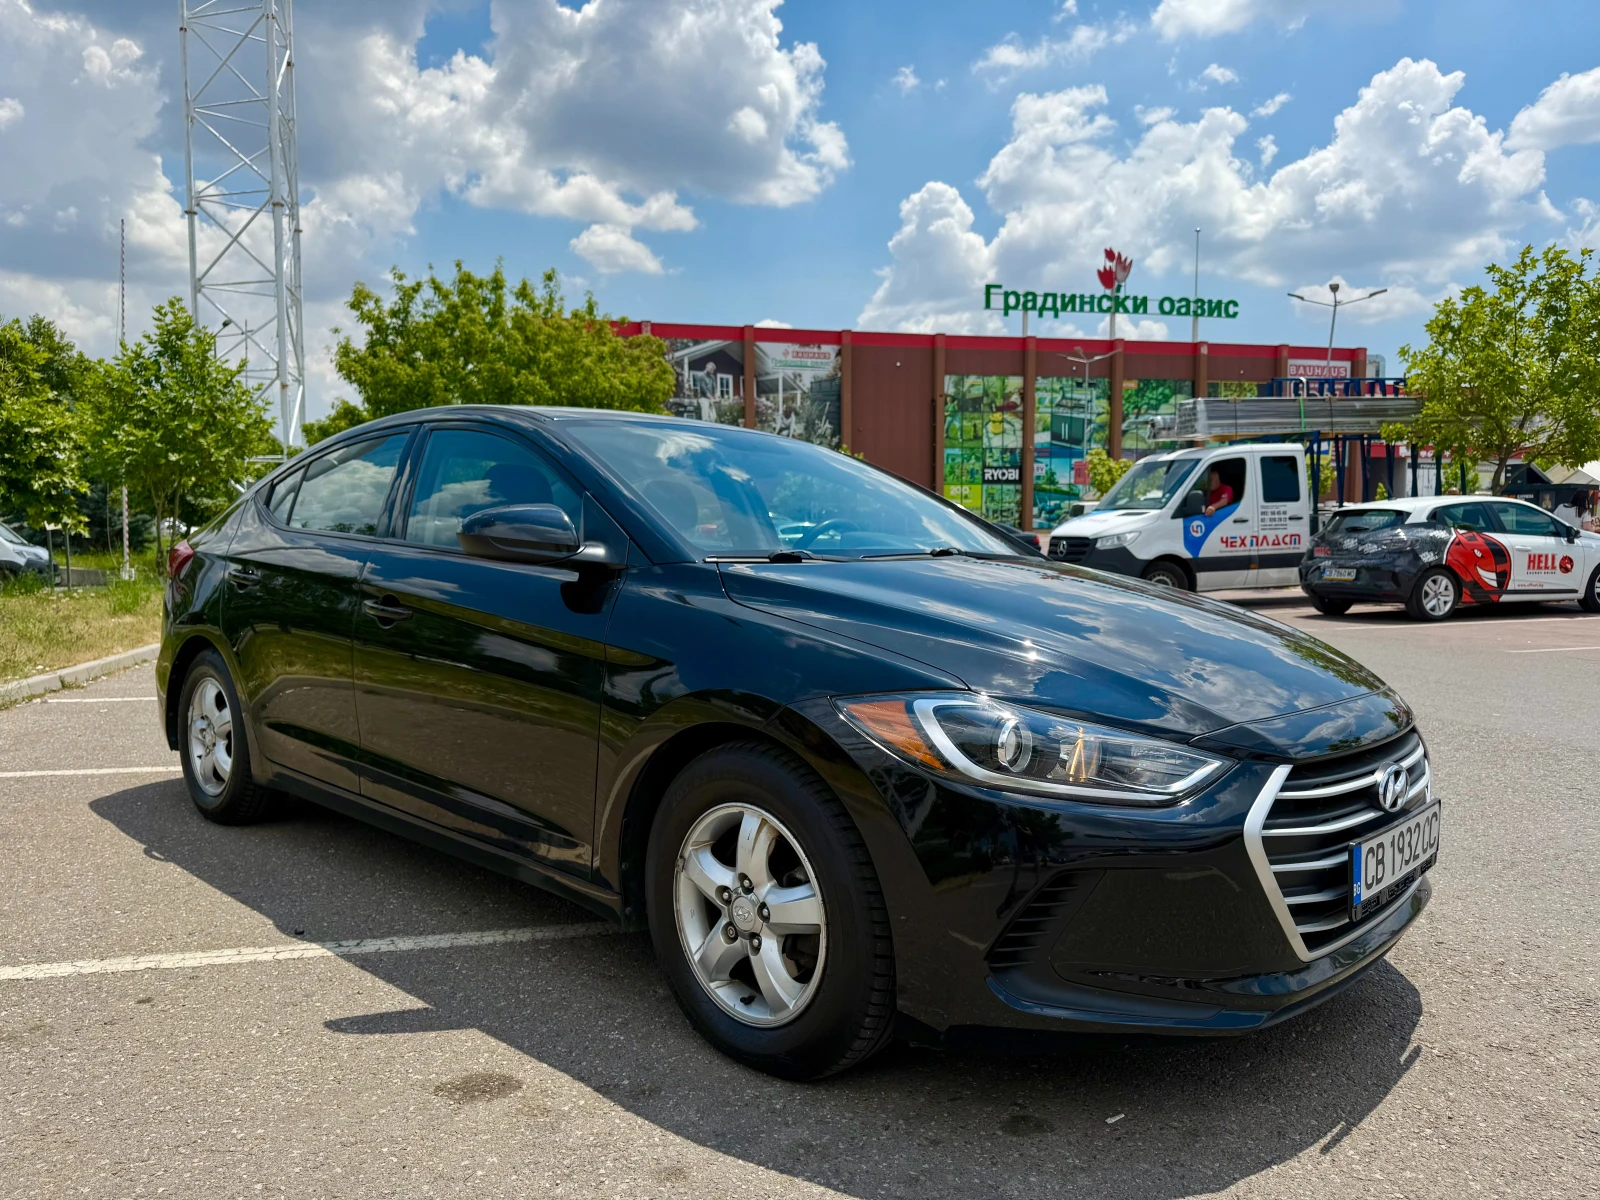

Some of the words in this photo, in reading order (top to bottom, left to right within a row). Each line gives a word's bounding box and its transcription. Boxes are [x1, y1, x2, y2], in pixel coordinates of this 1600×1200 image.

[985, 284, 1148, 319] Градински
[1158, 296, 1239, 319] оазис
[1289, 365, 1347, 377] BAUHAUS
[984, 468, 1020, 481] RYOBI
[1527, 553, 1557, 571] HELL
[1365, 841, 1386, 891] CB
[1391, 821, 1421, 877] 1932
[1422, 811, 1438, 854] CC
